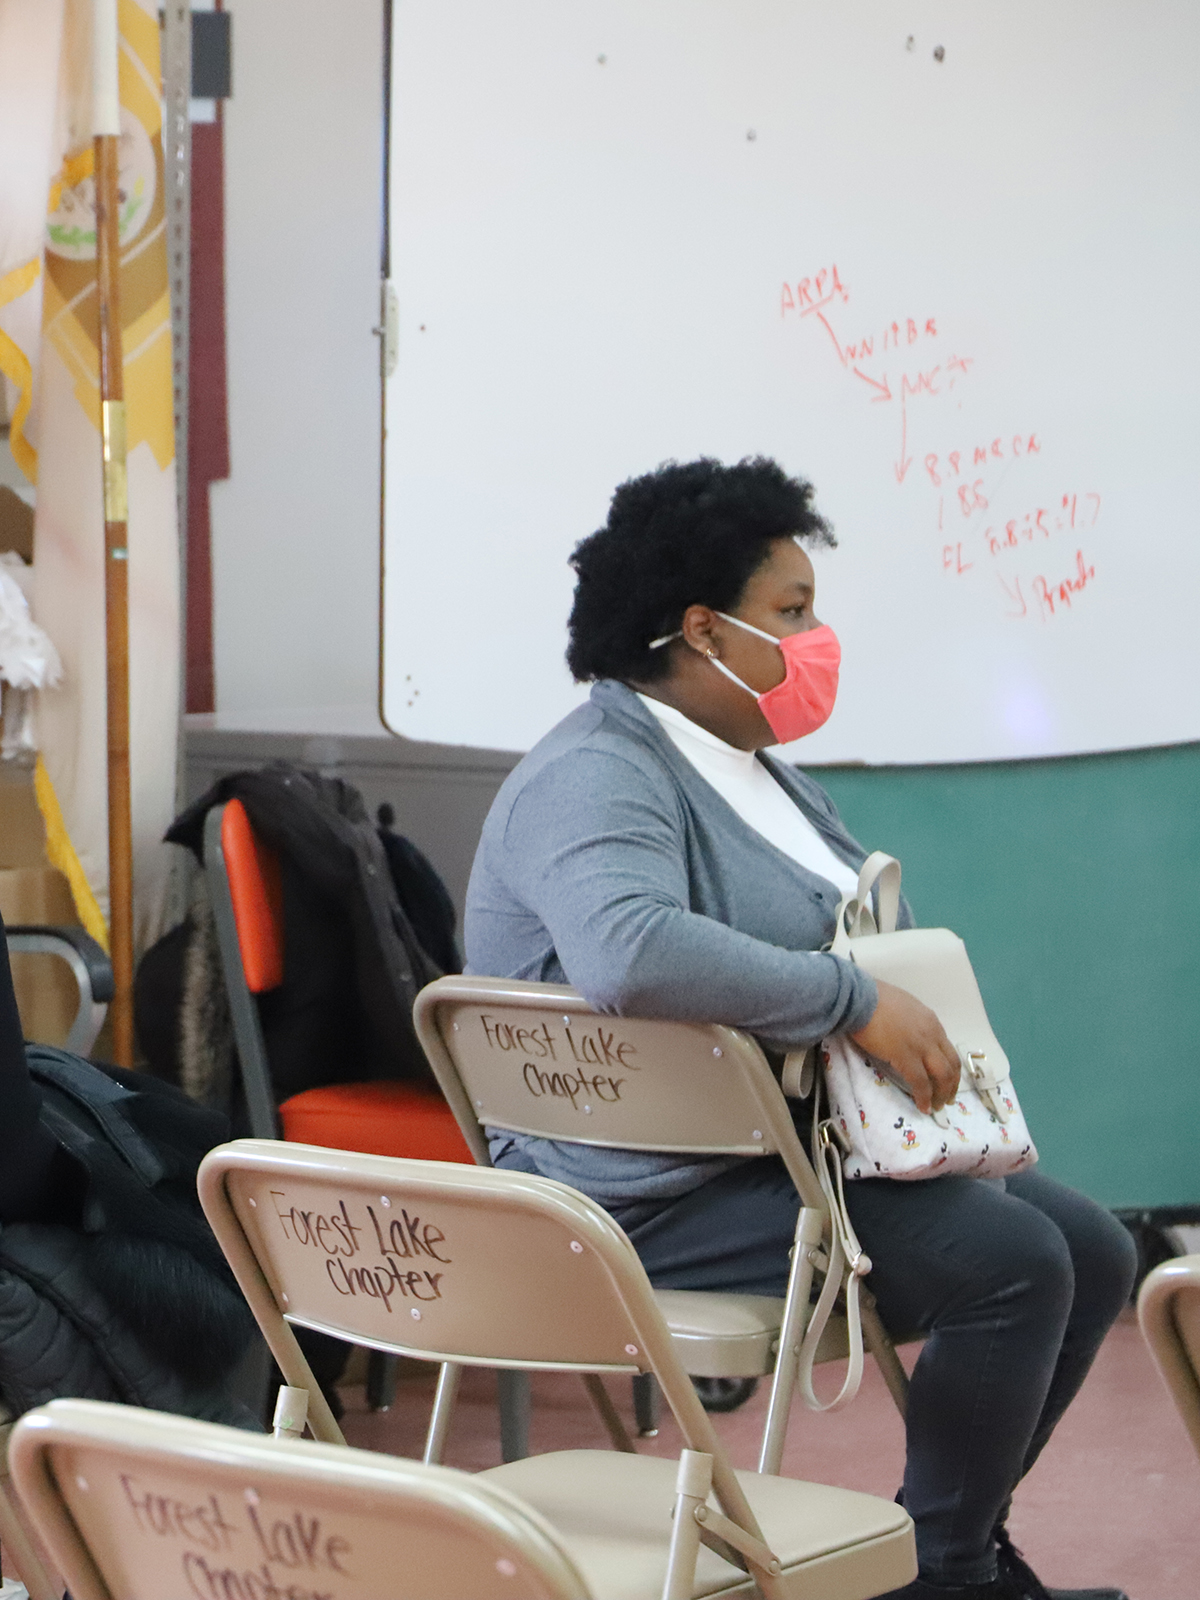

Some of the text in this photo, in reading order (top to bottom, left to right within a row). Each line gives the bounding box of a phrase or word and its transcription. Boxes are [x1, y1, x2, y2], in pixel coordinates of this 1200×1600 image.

[480, 1014, 641, 1071] Forest Lake
[523, 1062, 628, 1110] Chapter
[270, 1190, 452, 1264] Forest Lake
[326, 1257, 444, 1313] Chapter
[120, 1474, 358, 1580] Forest Lake
